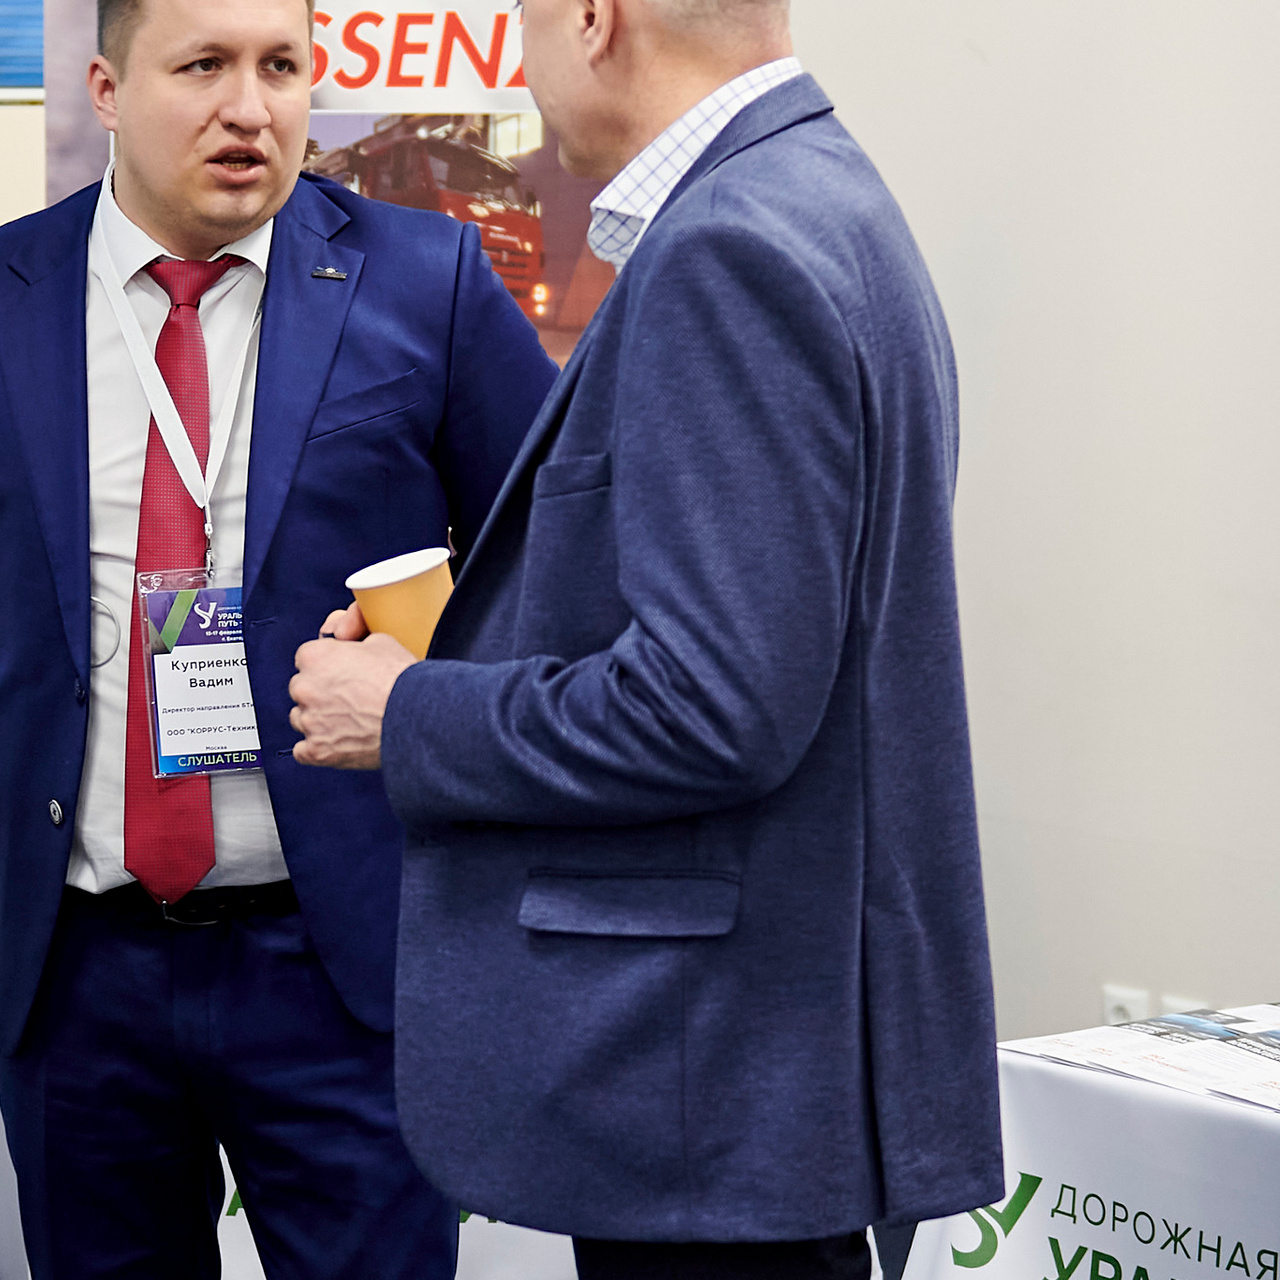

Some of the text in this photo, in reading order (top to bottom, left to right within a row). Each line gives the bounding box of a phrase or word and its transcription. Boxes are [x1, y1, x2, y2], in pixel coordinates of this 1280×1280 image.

[189, 678, 233, 688] Вадим
[167, 728, 185, 736] ООО
[178, 752, 257, 767] СЛУШАТЕЛЬ
